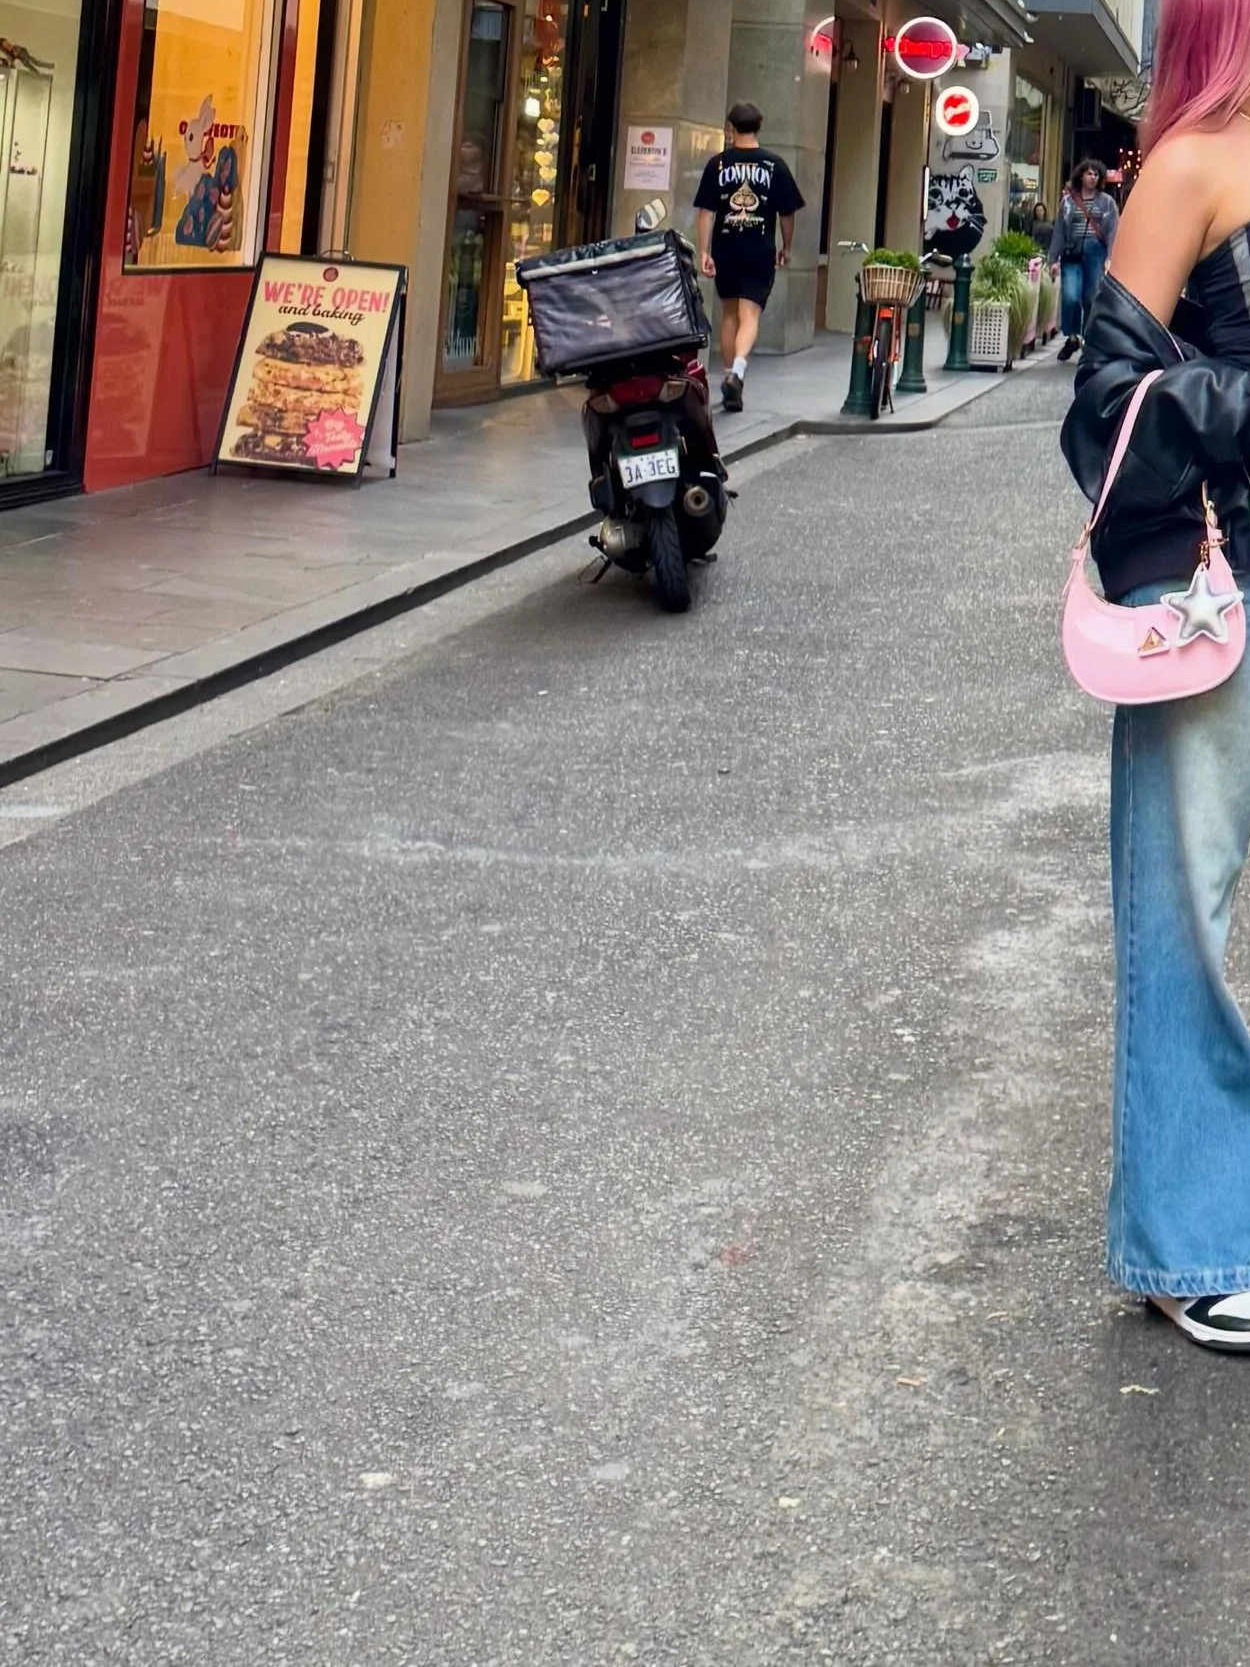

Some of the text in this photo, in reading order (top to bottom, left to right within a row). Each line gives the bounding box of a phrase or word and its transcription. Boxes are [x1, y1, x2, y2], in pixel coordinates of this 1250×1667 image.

[264, 280, 391, 313] WE'RE OPEN!
[278, 302, 365, 326] and baking
